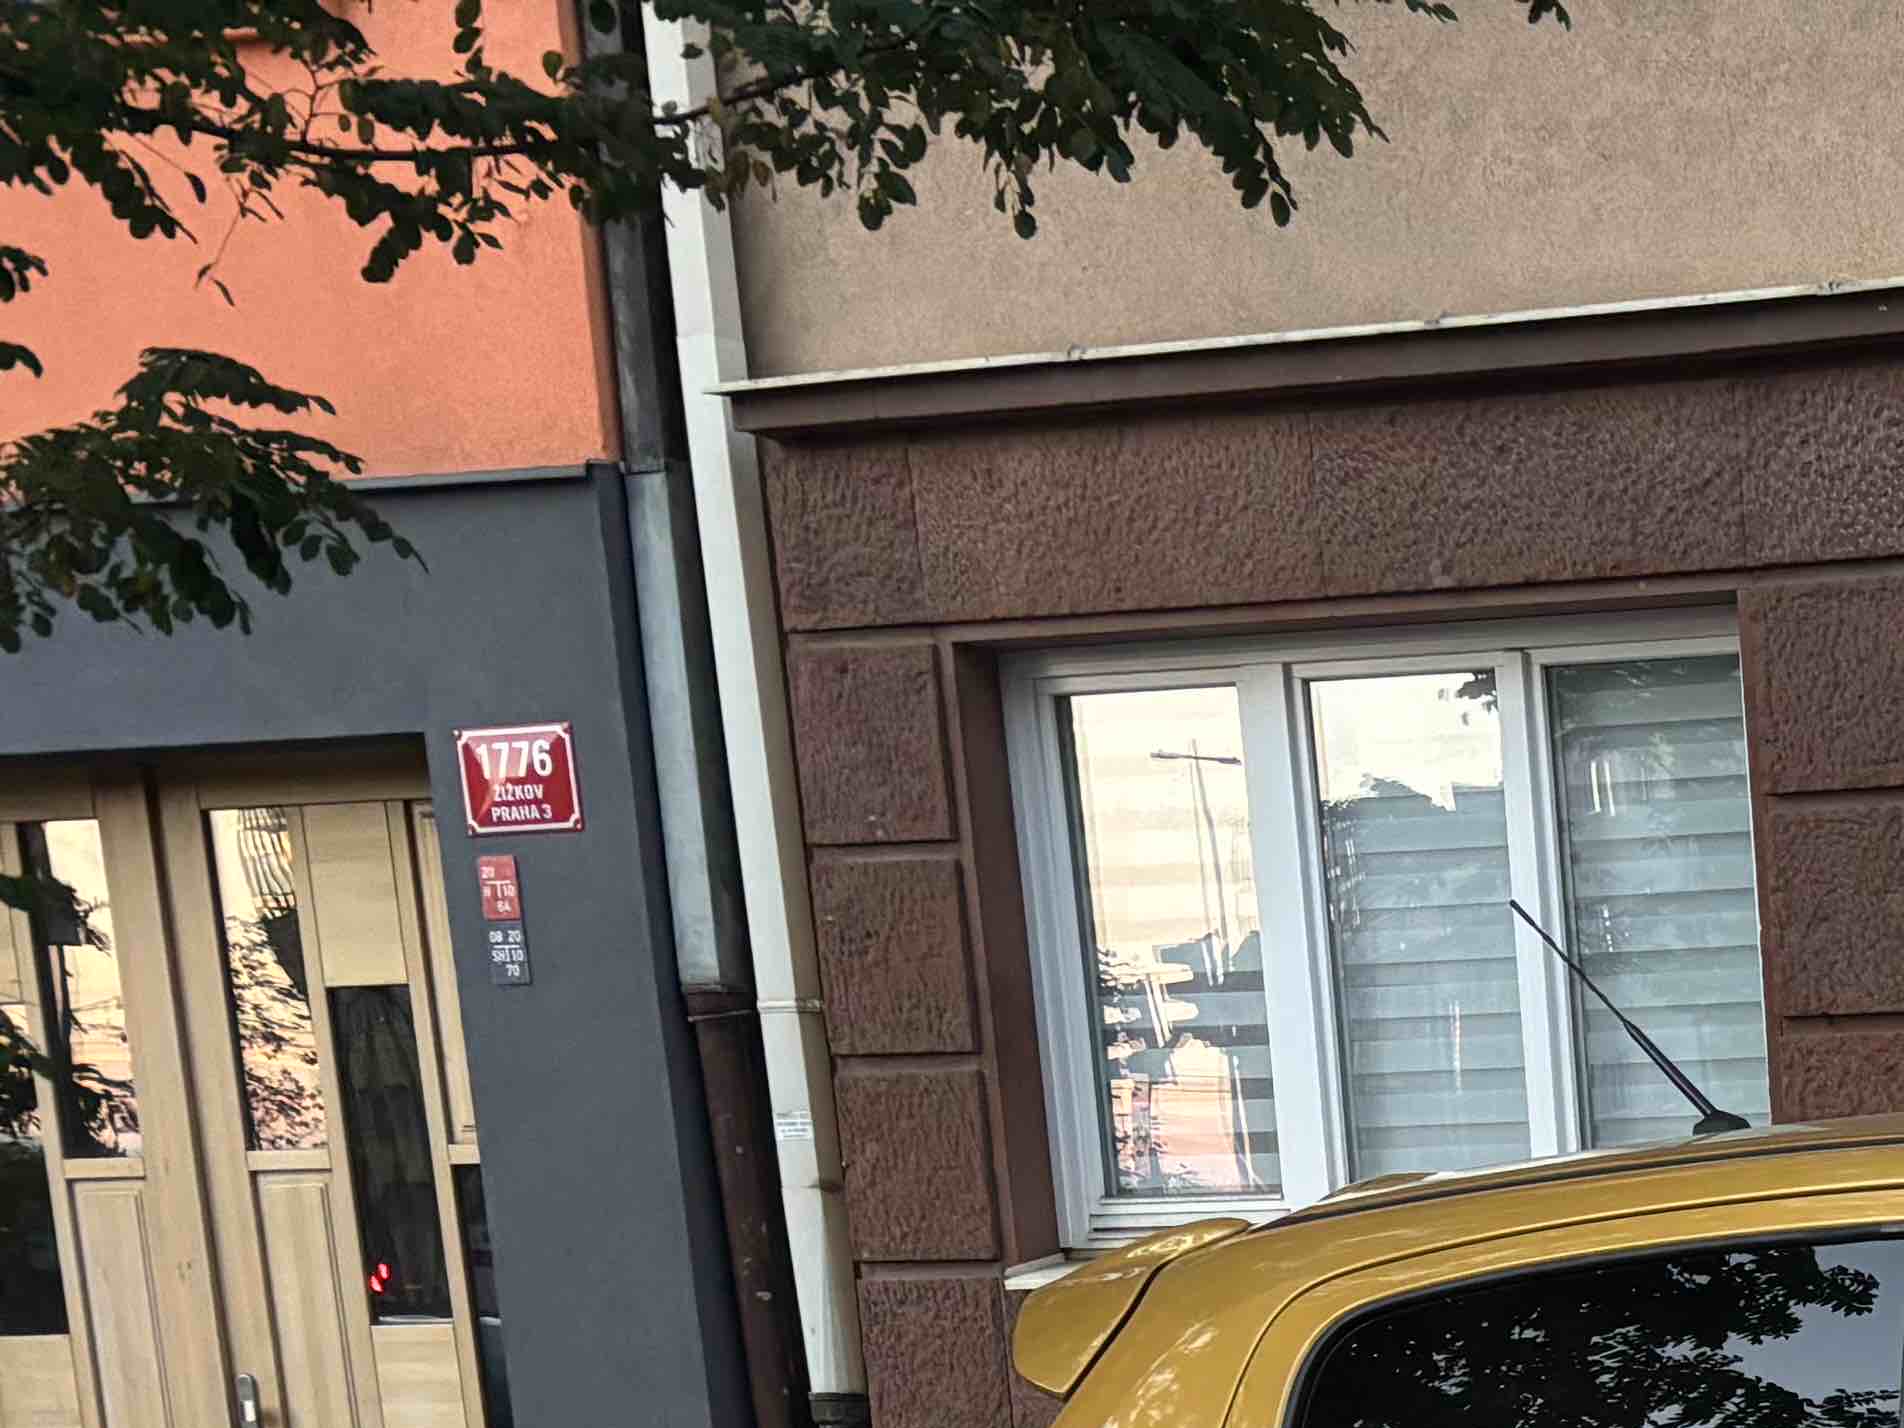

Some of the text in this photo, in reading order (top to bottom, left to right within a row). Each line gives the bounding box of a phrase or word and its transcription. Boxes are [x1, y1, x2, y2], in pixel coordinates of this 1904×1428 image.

[476, 739, 553, 780] 1776
[493, 781, 544, 802] ŽIŽKOV
[491, 803, 553, 822] PRAHA 3
[505, 964, 520, 977] 70
